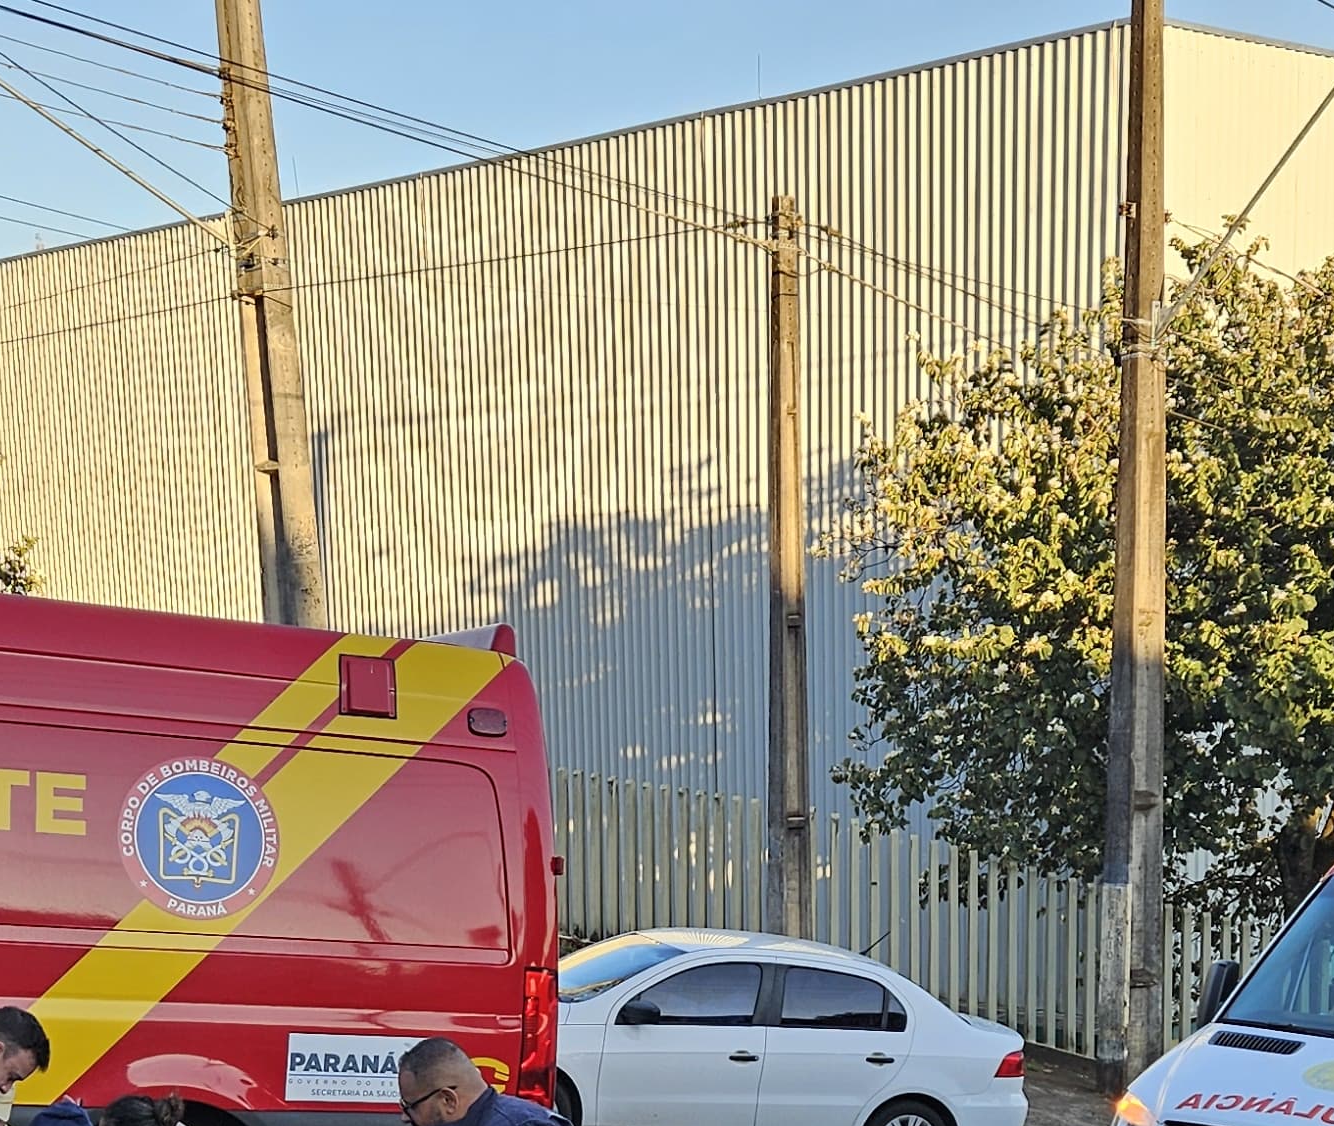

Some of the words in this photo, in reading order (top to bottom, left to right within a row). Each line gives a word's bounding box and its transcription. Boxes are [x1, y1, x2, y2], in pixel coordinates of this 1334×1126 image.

[120, 796, 140, 857] CORPO
[137, 773, 159, 795] DE
[160, 759, 257, 797] BOMBEIROS
[255, 799, 277, 868] MILITAR
[167, 899, 227, 917] PARANÁ
[289, 1052, 398, 1074] PARANÁ
[288, 1078, 347, 1086] GOVERNO
[357, 1079, 371, 1087] DO
[311, 1088, 360, 1097] SECRETARIA
[362, 1089, 374, 1097] DA
[376, 1087, 398, 1098] SAÚD
